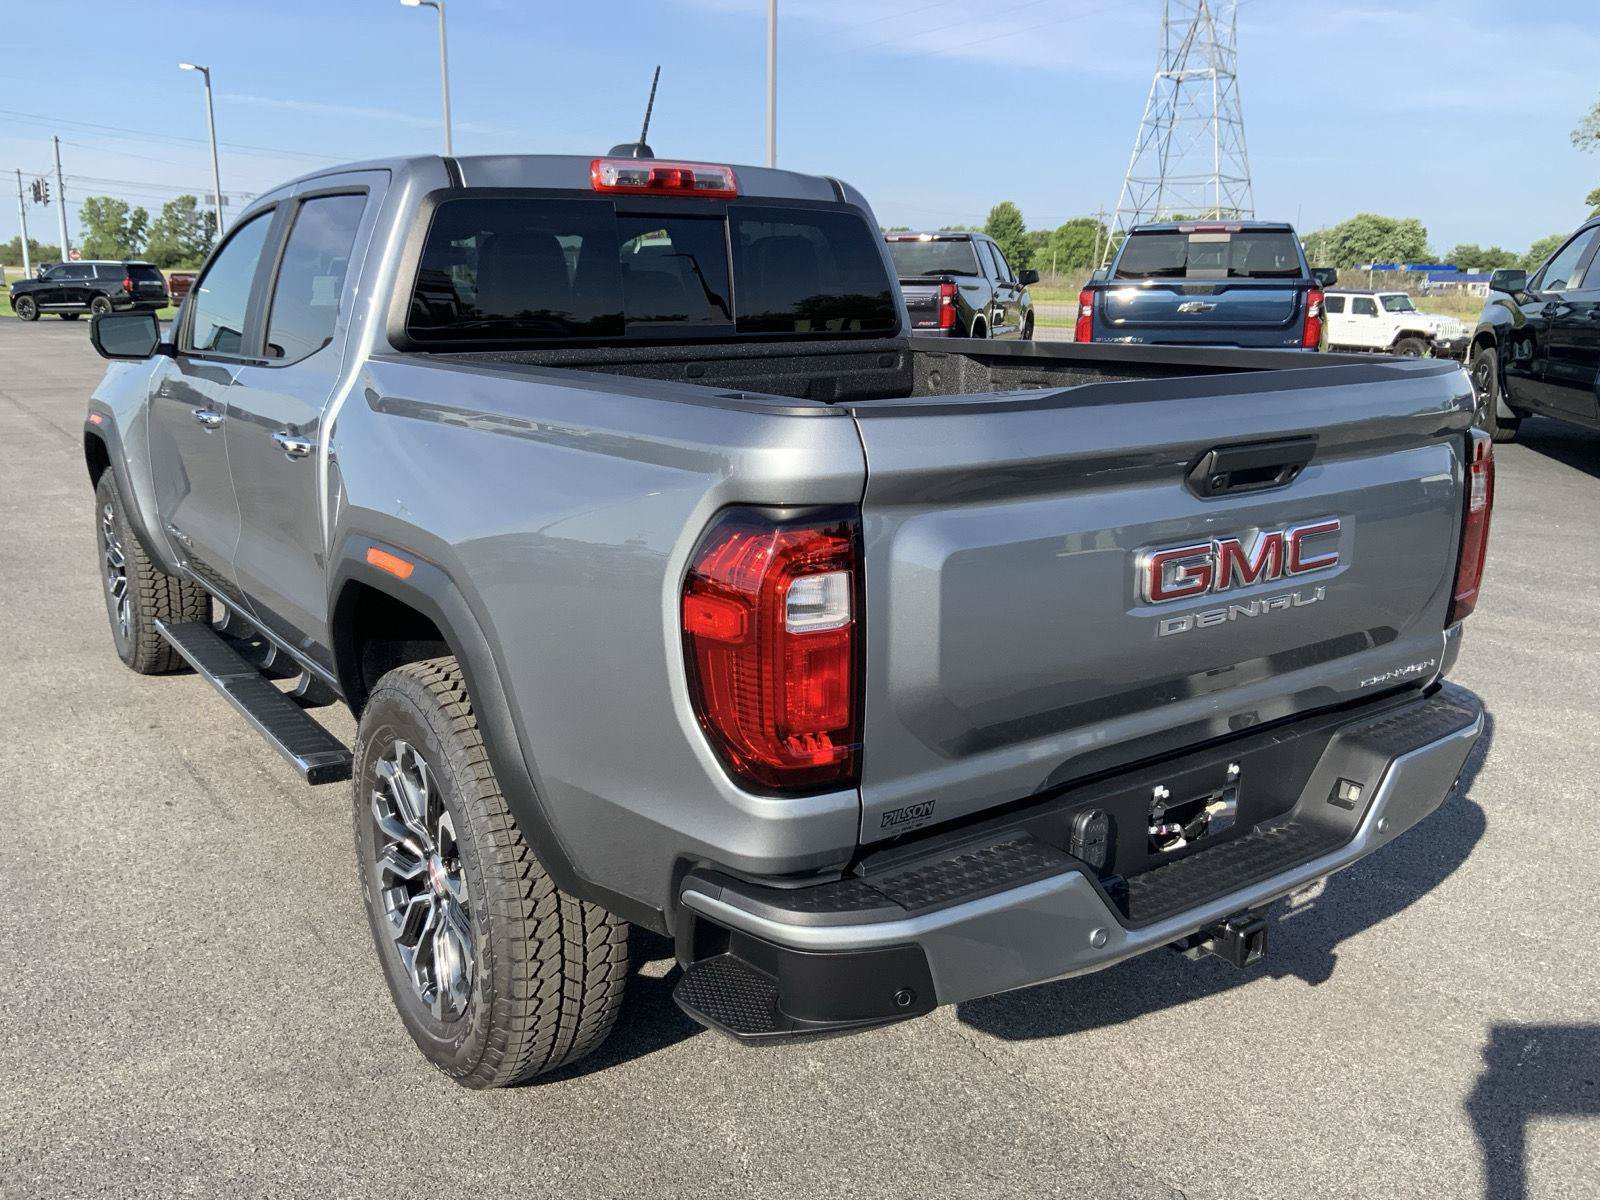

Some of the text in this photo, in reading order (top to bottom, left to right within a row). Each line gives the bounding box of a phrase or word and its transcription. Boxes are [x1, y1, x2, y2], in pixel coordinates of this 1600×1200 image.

[1142, 517, 1341, 604] GMC
[1157, 584, 1327, 638] DENALI
[1360, 658, 1437, 688] CANYON
[880, 799, 937, 828] PILSON
